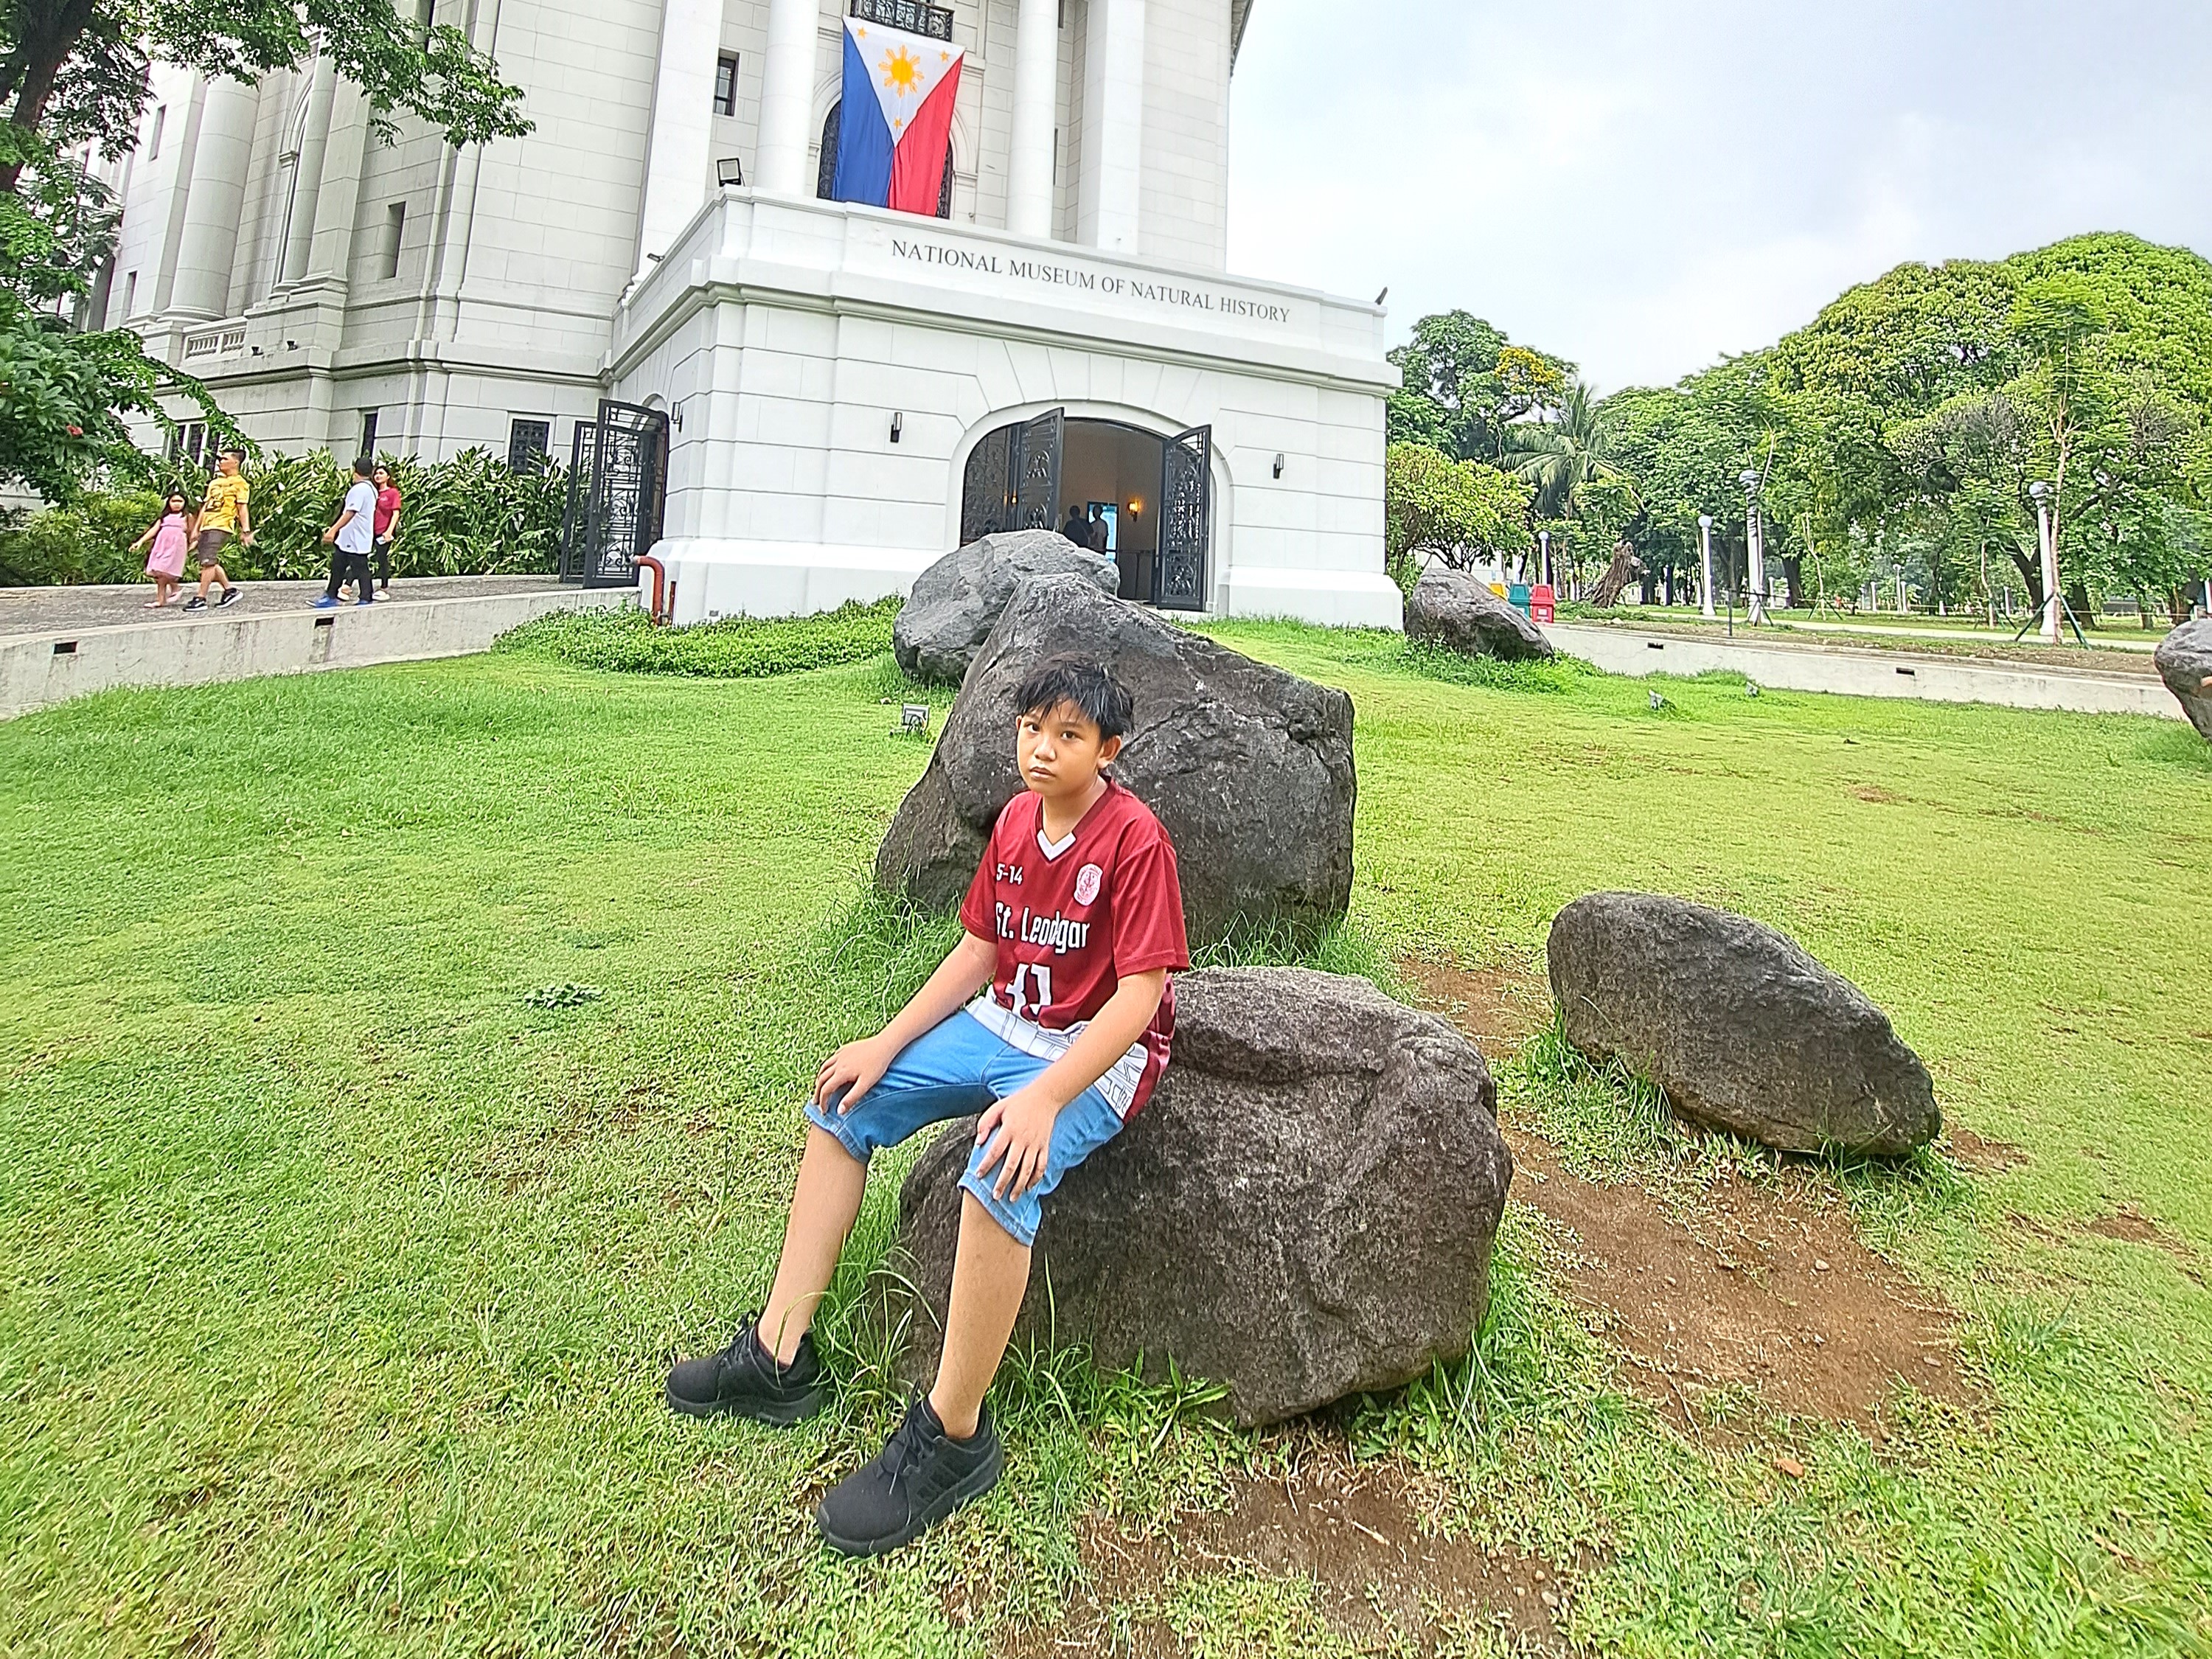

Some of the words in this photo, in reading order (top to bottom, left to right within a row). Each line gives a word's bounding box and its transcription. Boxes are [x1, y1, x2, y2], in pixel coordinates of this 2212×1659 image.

[891, 240, 1003, 274] NATIONAL
[1009, 260, 1095, 290] MUSEUM
[1102, 276, 1125, 293] OF
[1130, 281, 1214, 310] NATURAL
[1220, 297, 1290, 322] HISTORY
